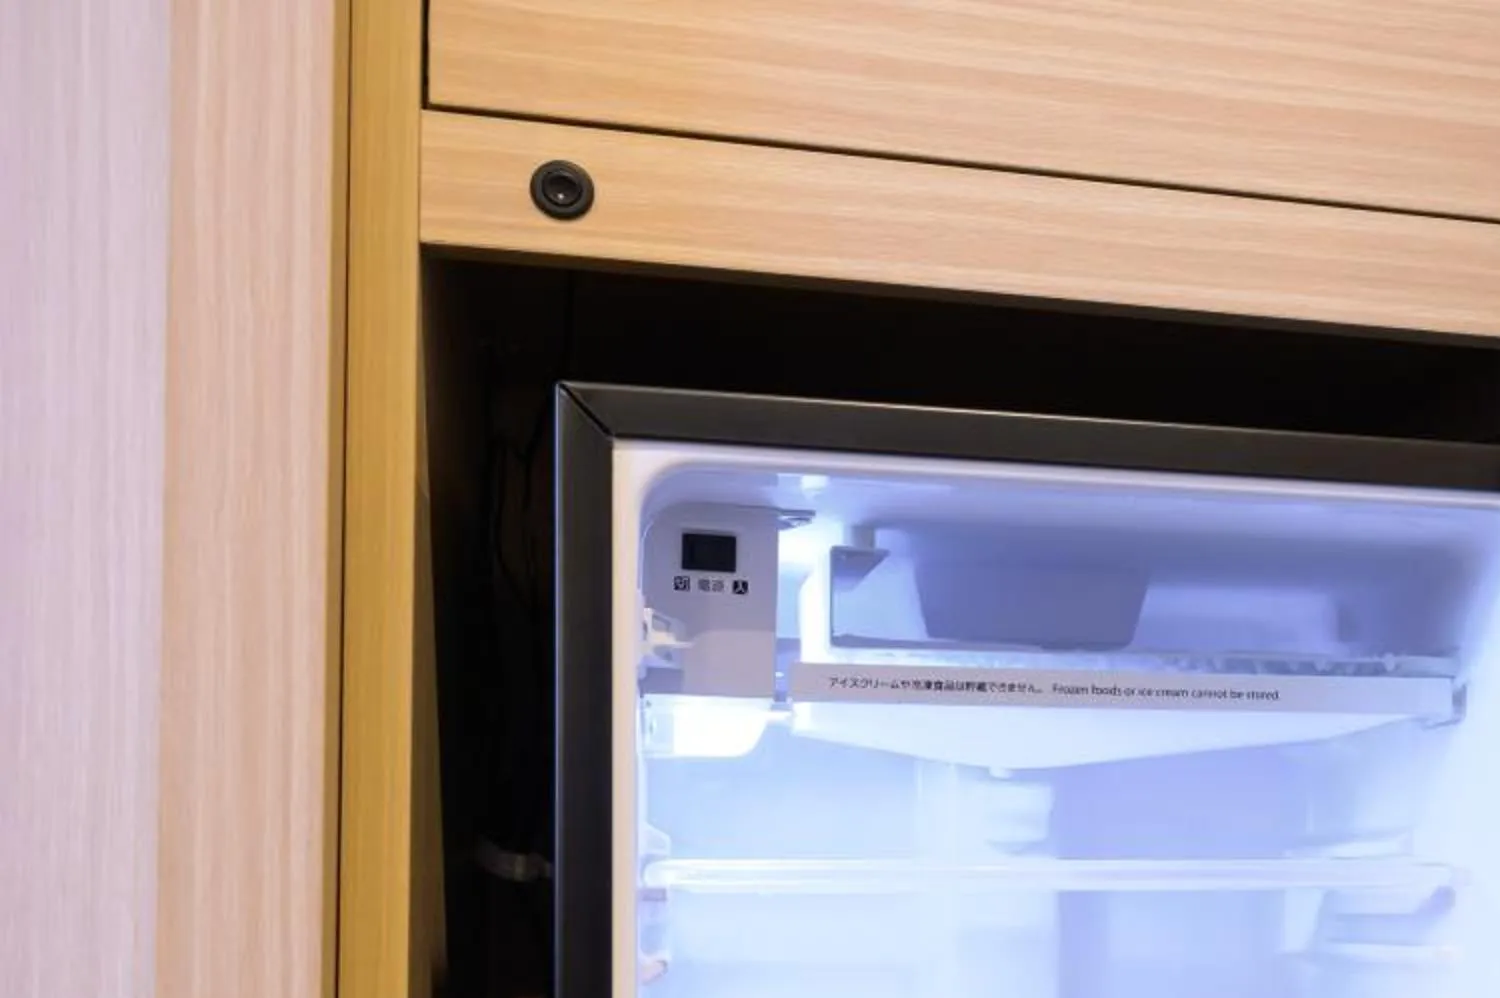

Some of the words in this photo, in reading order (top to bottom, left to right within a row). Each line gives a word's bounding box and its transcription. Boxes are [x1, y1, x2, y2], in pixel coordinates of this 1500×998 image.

[698, 578, 725, 592] 電源
[733, 580, 749, 595] 入
[1052, 682, 1089, 695] Frozen
[1091, 683, 1121, 697] foods
[1124, 687, 1135, 697] or
[1138, 685, 1152, 697] ice
[1155, 688, 1189, 698] cream
[1191, 687, 1228, 699] cannot
[1230, 688, 1244, 699] be
